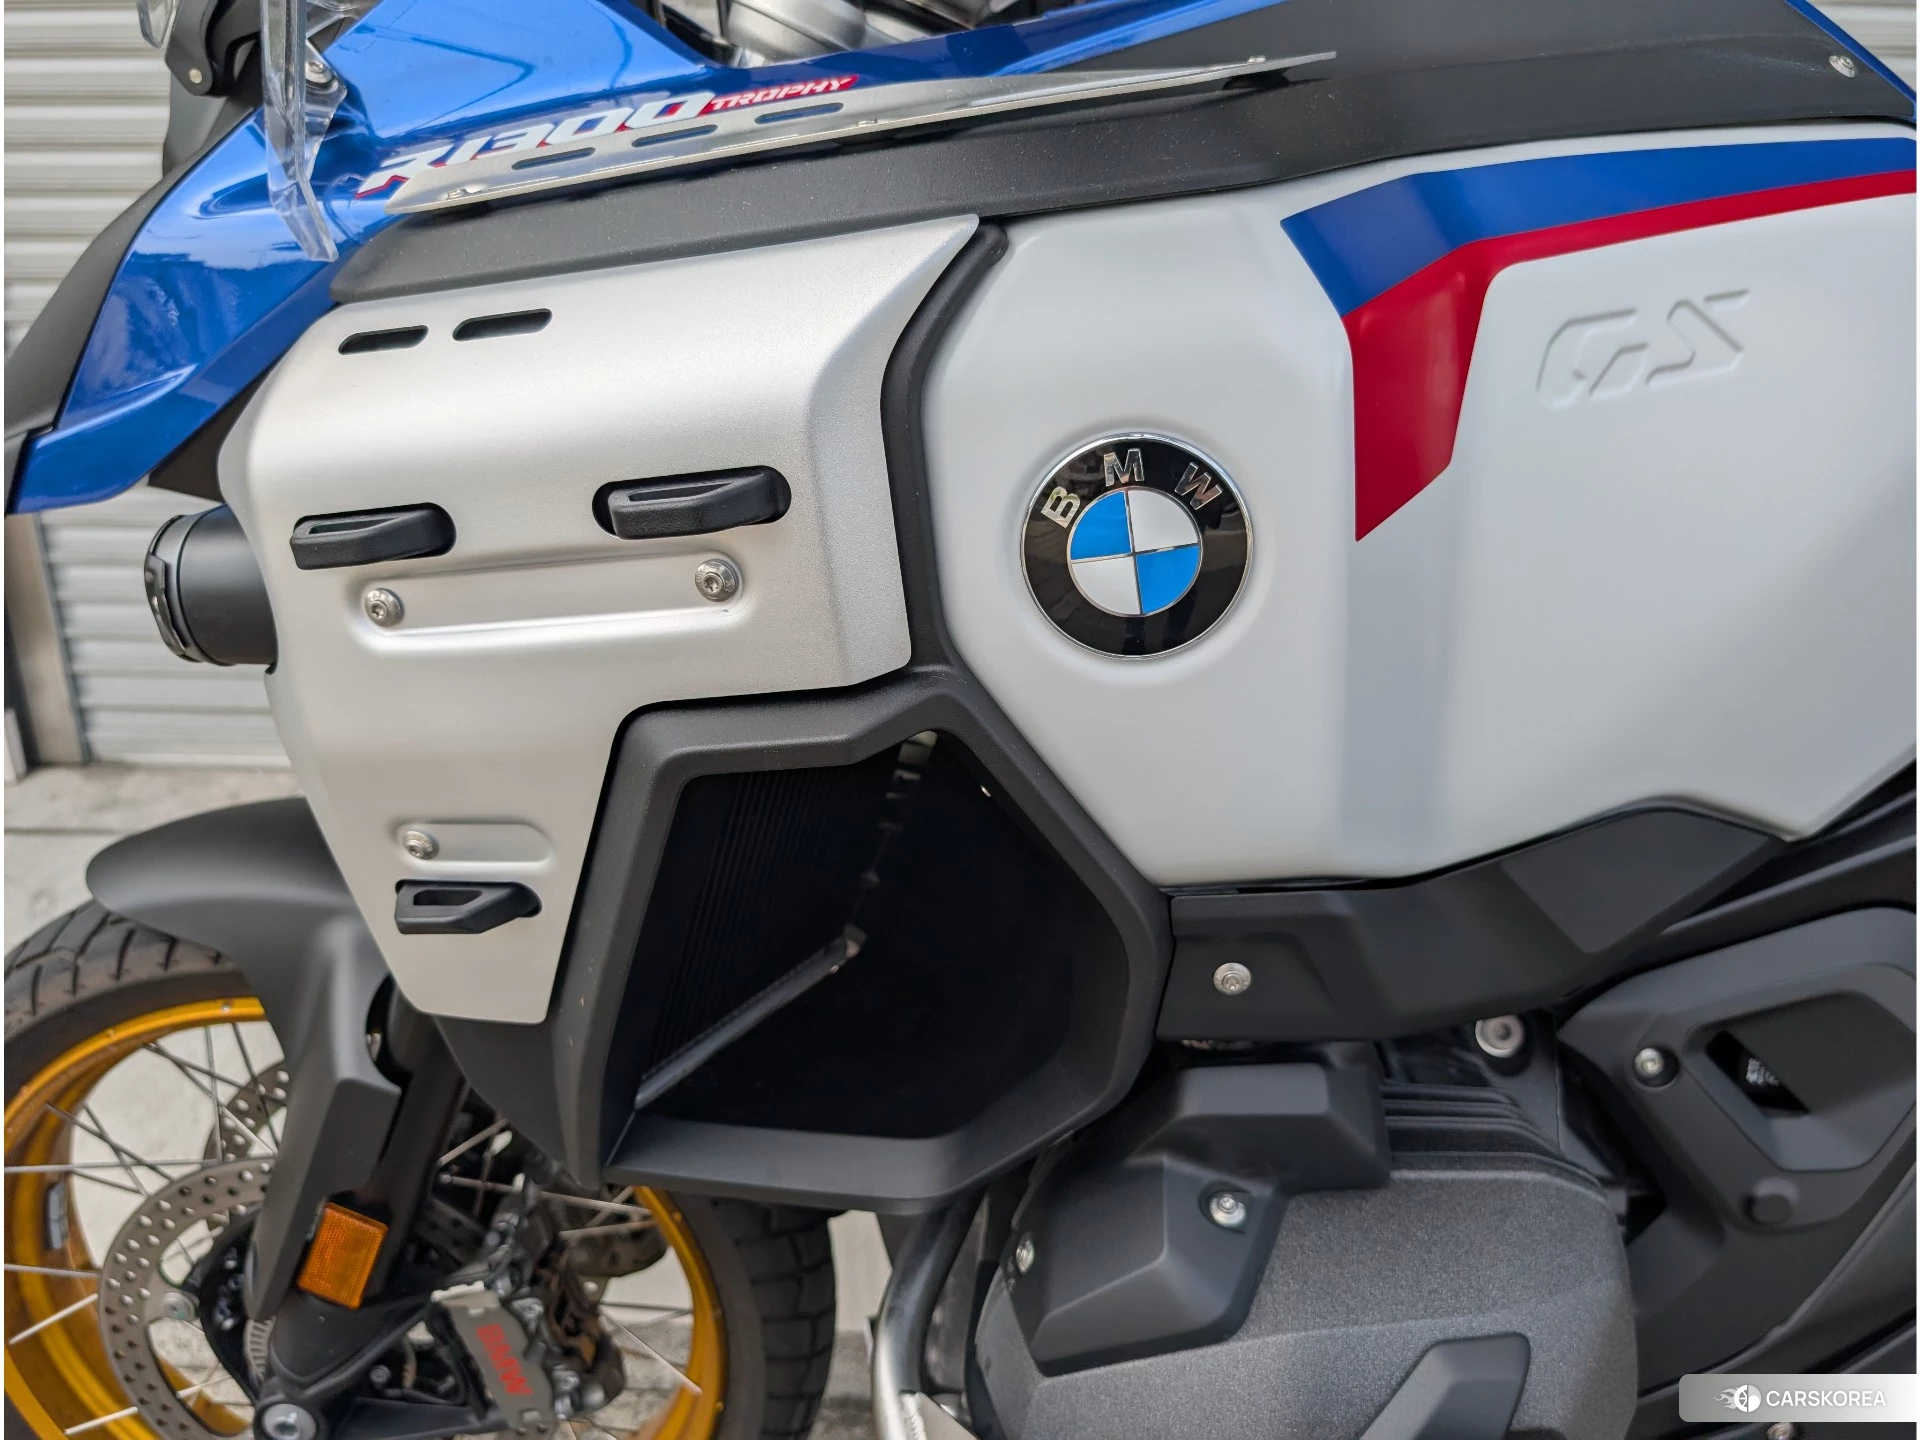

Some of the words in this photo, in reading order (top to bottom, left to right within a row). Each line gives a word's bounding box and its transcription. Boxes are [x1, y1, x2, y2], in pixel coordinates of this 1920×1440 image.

[711, 77, 853, 111] TROPHY
[1535, 287, 1750, 409] GS
[1040, 448, 1223, 529] BMW
[476, 1323, 534, 1395] BMW
